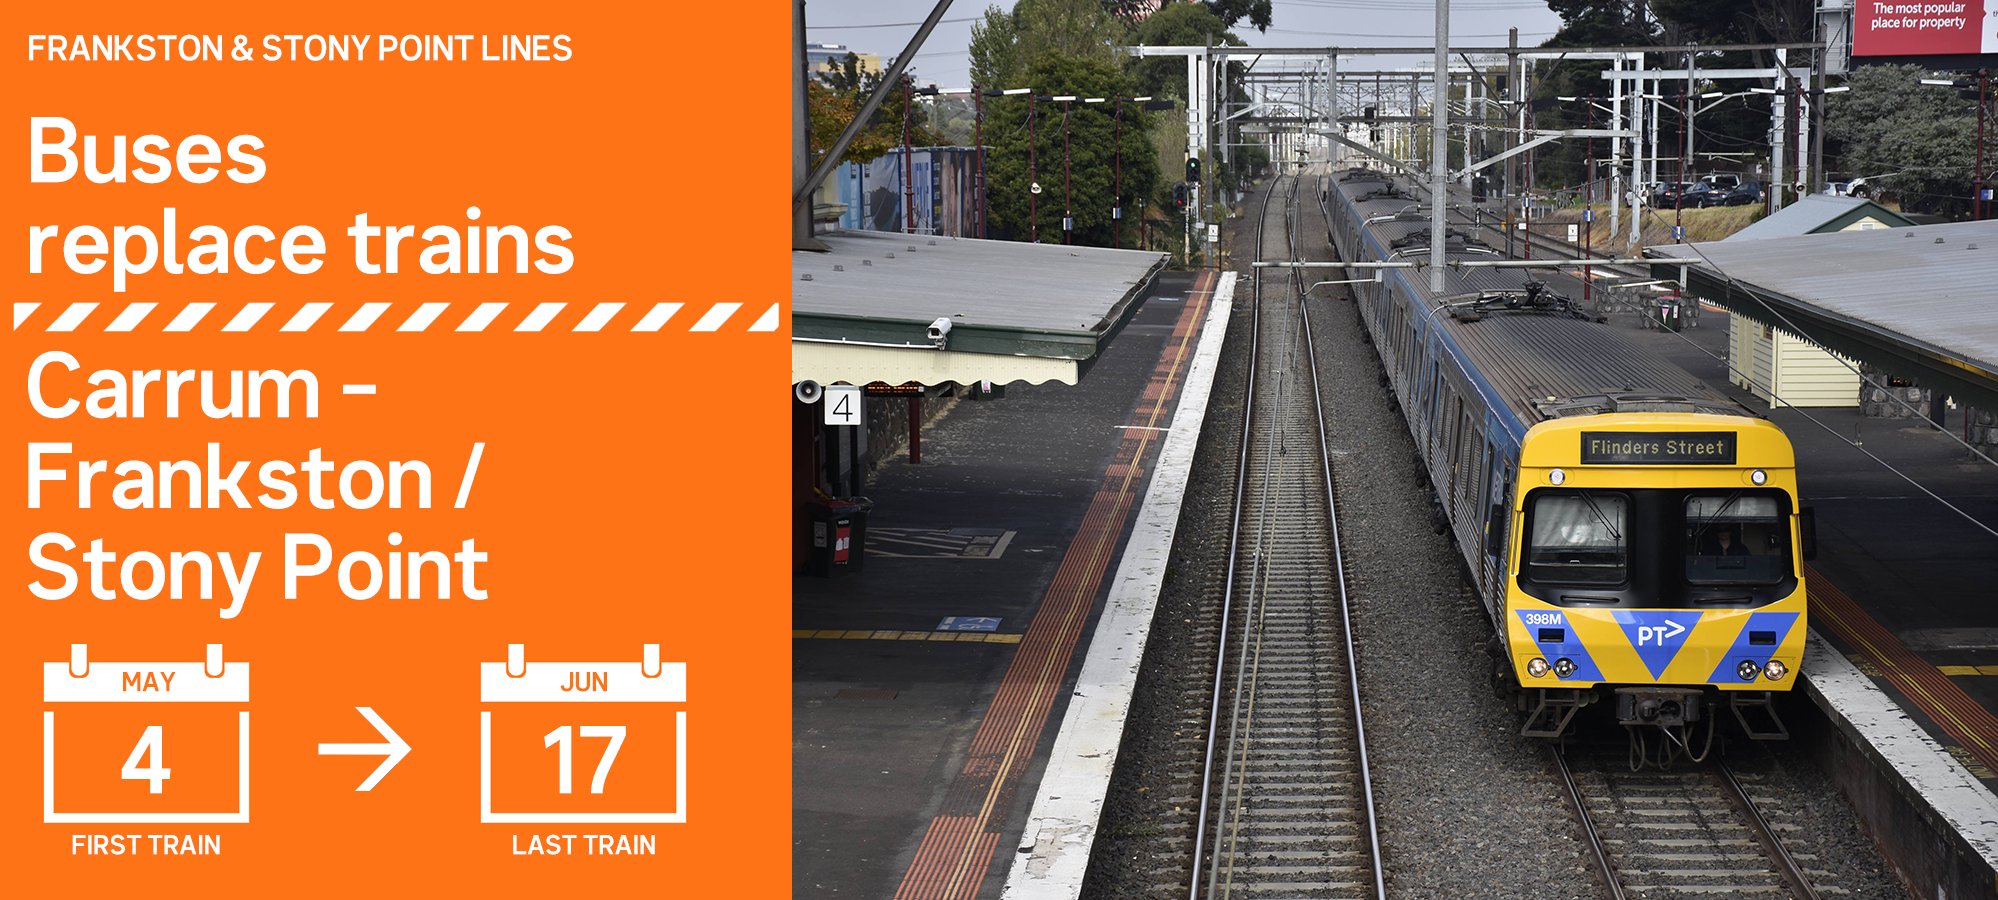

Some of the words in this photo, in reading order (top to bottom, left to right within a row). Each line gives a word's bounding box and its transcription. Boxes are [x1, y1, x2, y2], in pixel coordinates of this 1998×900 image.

[1873, 2, 1893, 14] The
[1895, 3, 1922, 14] most
[1924, 3, 1966, 16] popular
[1871, 17, 1901, 31] place
[1902, 17, 1918, 28] for
[1919, 17, 1966, 31] property
[832, 393, 853, 422] 4
[1591, 440, 1659, 455] Flinders
[1666, 440, 1724, 455] Street
[1525, 613, 1562, 625] 398M
